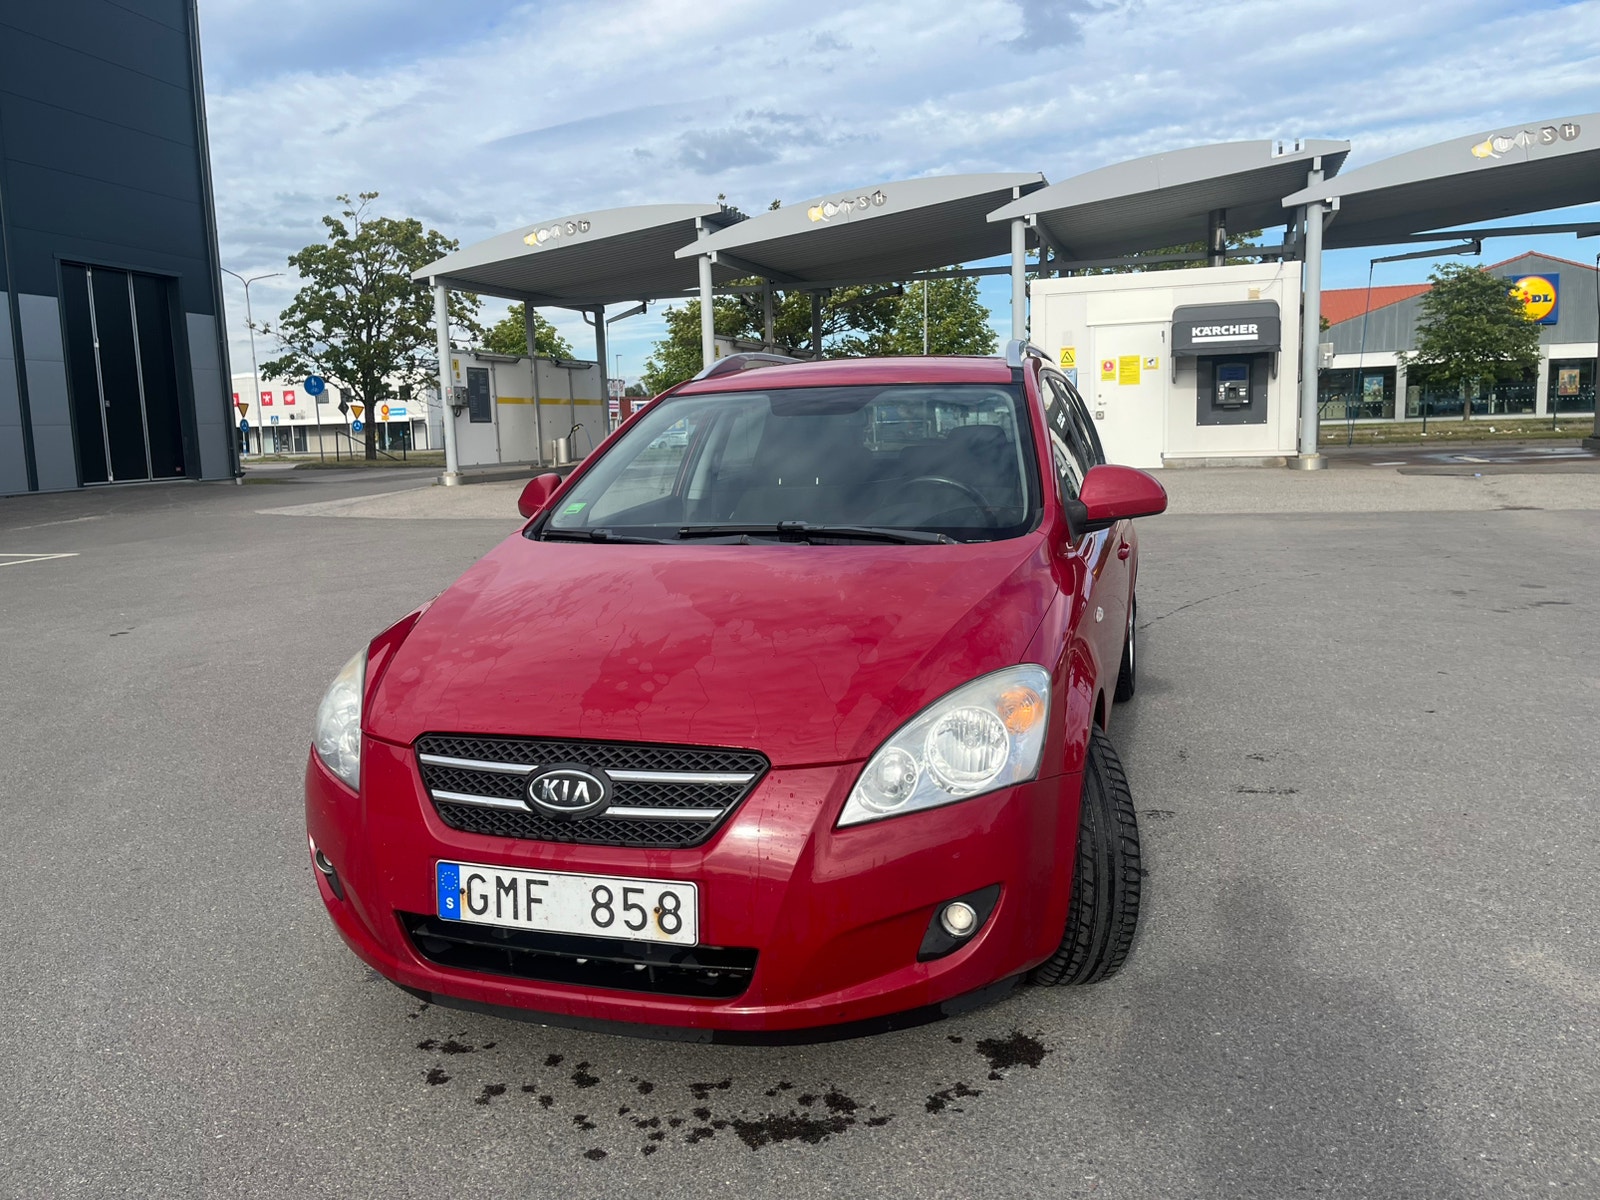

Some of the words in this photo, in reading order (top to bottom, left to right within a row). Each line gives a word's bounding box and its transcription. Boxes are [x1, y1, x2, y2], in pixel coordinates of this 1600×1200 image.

[1191, 323, 1258, 337] KÄRCHER
[541, 778, 591, 803] KIA
[446, 897, 455, 910] S
[466, 873, 549, 922] GMF
[590, 884, 683, 935] 858
